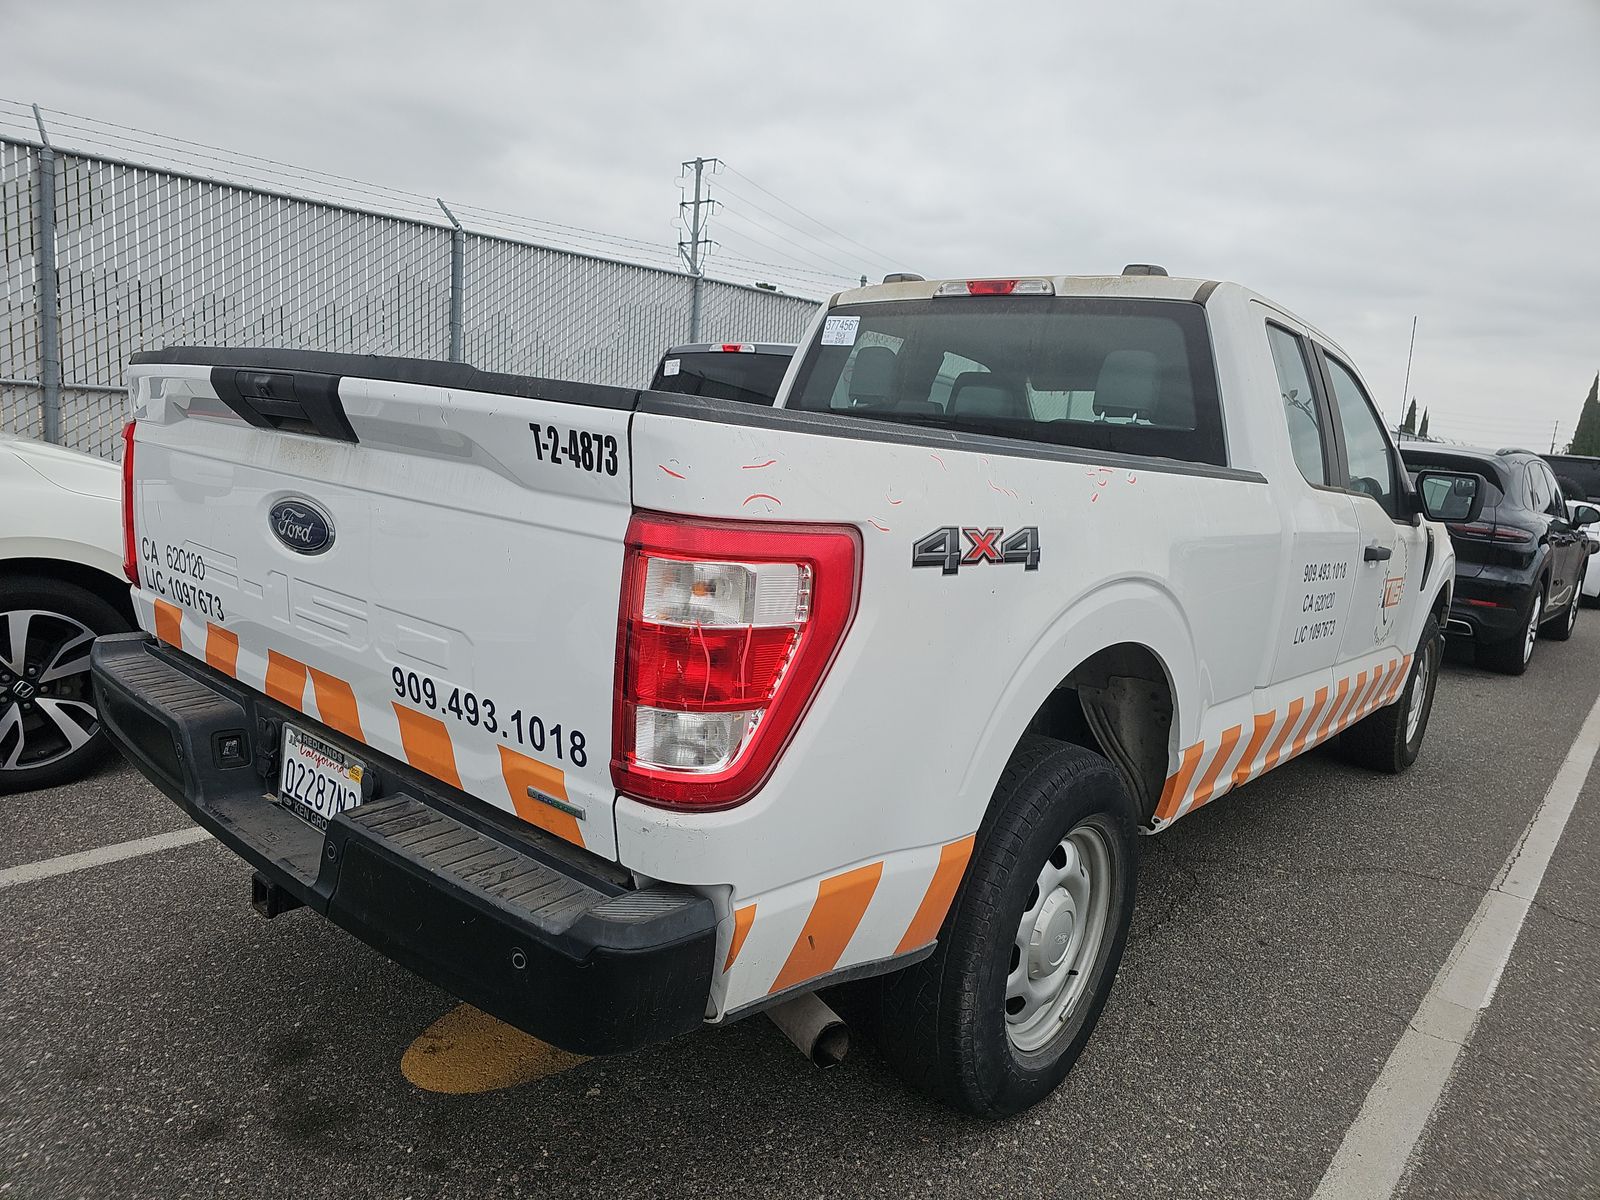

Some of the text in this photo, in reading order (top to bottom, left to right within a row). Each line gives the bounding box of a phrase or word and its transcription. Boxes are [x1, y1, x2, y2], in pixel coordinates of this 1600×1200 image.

[825, 319, 860, 331] 3774567
[529, 422, 618, 477] T-2-4873
[278, 507, 314, 543] Ford
[142, 537, 206, 581] CA 620120
[1303, 562, 1347, 583] 909.493.1018
[145, 565, 225, 622] LIC 1097673
[1303, 594, 1314, 613] CA
[1293, 625, 1308, 645] LIC
[391, 666, 587, 768] 909.493.1018
[302, 734, 344, 763] REDLANDS
